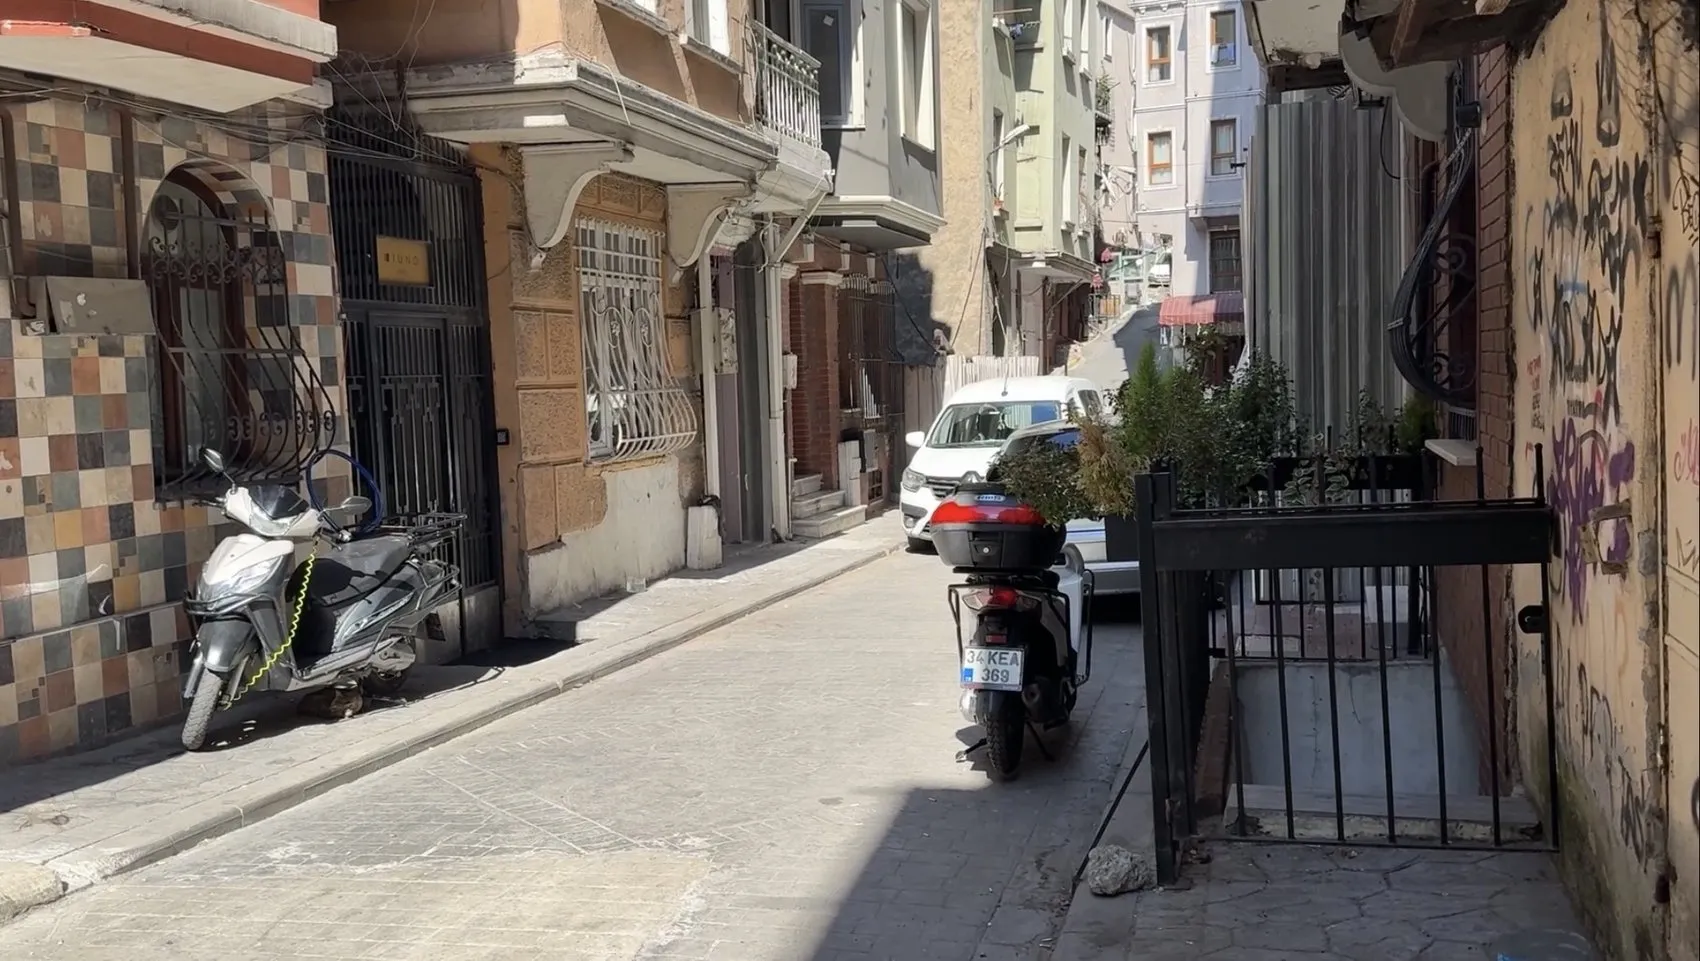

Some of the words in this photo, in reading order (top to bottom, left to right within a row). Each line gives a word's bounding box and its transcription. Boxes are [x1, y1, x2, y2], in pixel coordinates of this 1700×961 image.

[967, 651, 984, 664] 34
[988, 651, 1019, 666] KEA
[981, 668, 1010, 683] 369
